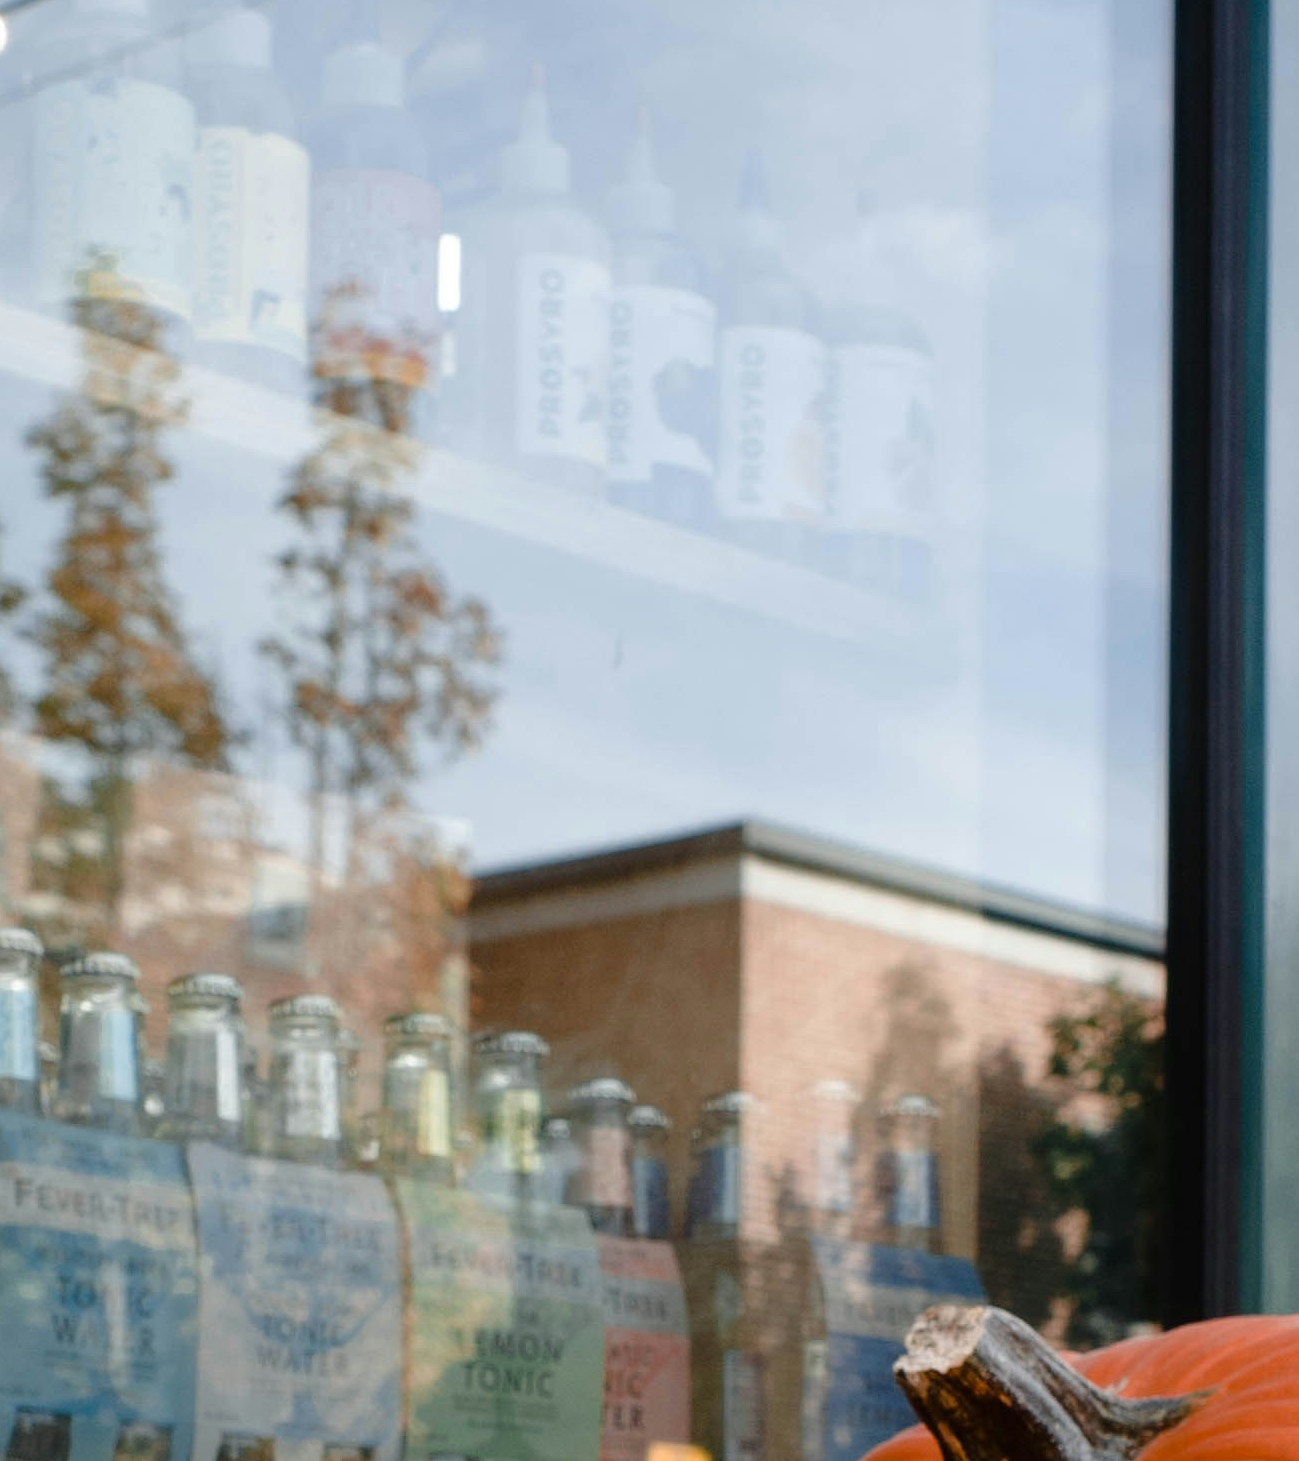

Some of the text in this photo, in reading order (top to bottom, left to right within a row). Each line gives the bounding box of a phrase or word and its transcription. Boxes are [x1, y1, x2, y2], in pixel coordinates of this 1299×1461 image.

[536, 268, 566, 438] PROSYRO
[608, 300, 636, 466] PROSYRO
[737, 343, 767, 505] PROSYRO
[57, 1273, 155, 1319] TOC
[460, 1360, 557, 1400] TONIC
